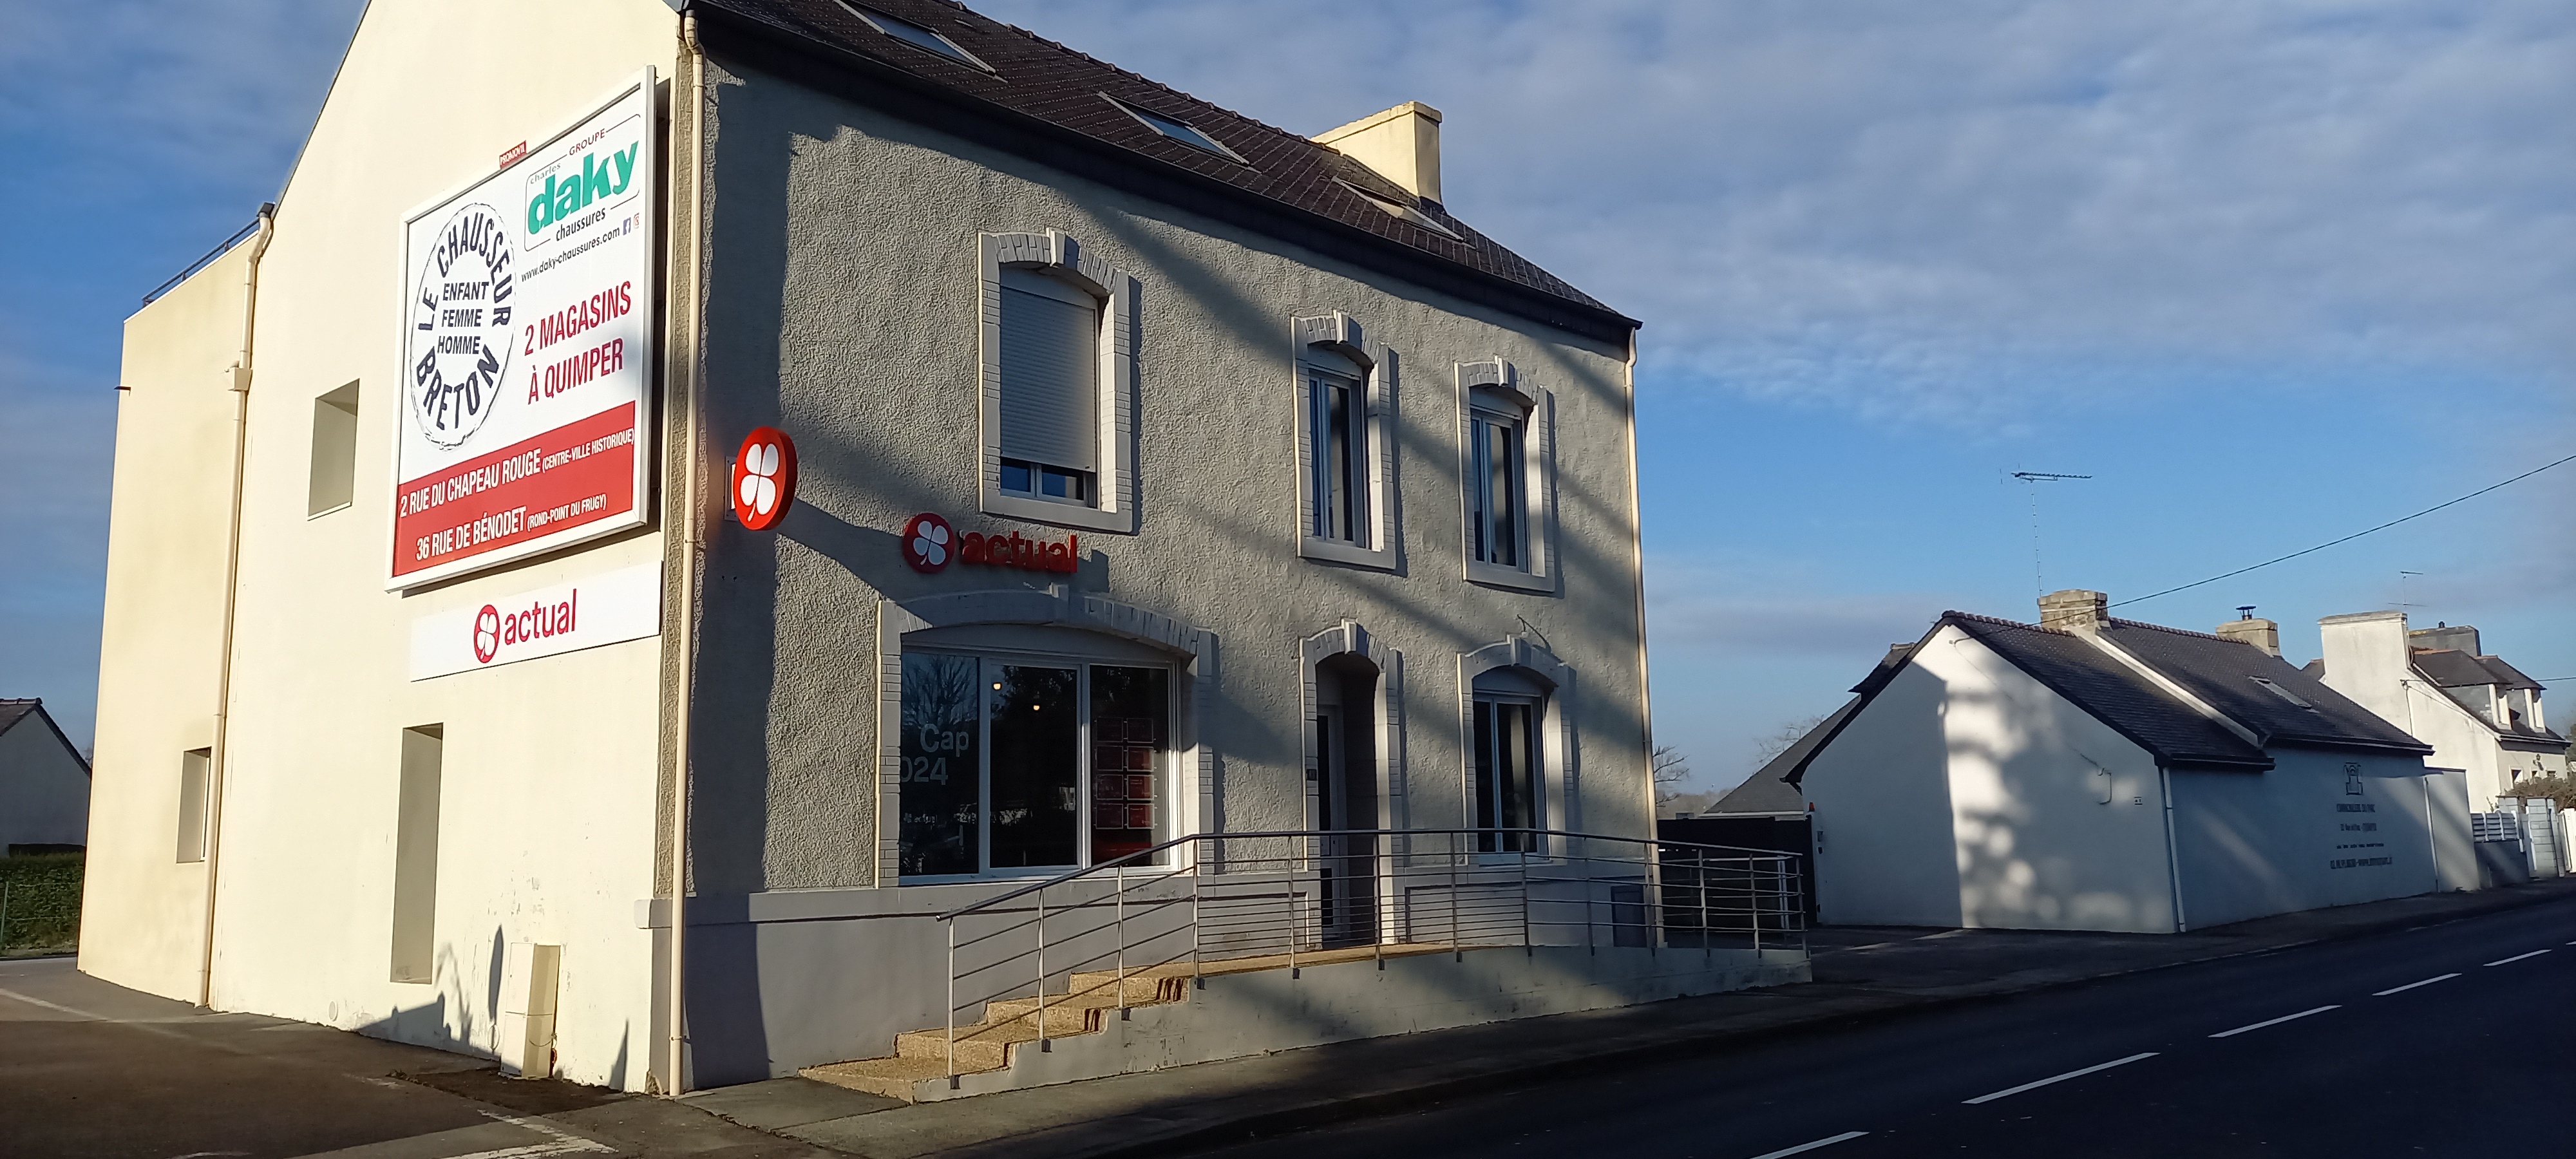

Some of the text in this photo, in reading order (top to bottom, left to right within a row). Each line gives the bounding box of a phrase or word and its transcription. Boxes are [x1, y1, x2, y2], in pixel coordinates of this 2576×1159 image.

[569, 128, 605, 156] GROUPE
[527, 140, 639, 235] daky
[530, 163, 561, 184] charles
[556, 207, 605, 241] chaussures
[418, 212, 512, 330] LE CHAUSSEUR
[522, 227, 620, 282] www.daky-chaussures.com
[441, 308, 482, 327] FEMME
[442, 281, 489, 301] ENFANT
[524, 281, 631, 356] 2 MAGASINS
[437, 335, 481, 354] HOMME
[527, 338, 623, 405] À QUIMPER
[416, 344, 499, 430] BRETON
[400, 428, 634, 518] 2 RUE DU CHAPEAU ROUGE (CENTRE-VILLE HISTORIQUE)
[416, 493, 607, 560] 36 RUE DE BÉNODET (ROND-POINT DU FRUGY)
[961, 531, 1077, 573] actual
[504, 588, 577, 645] actual
[920, 723, 969, 757] Cap
